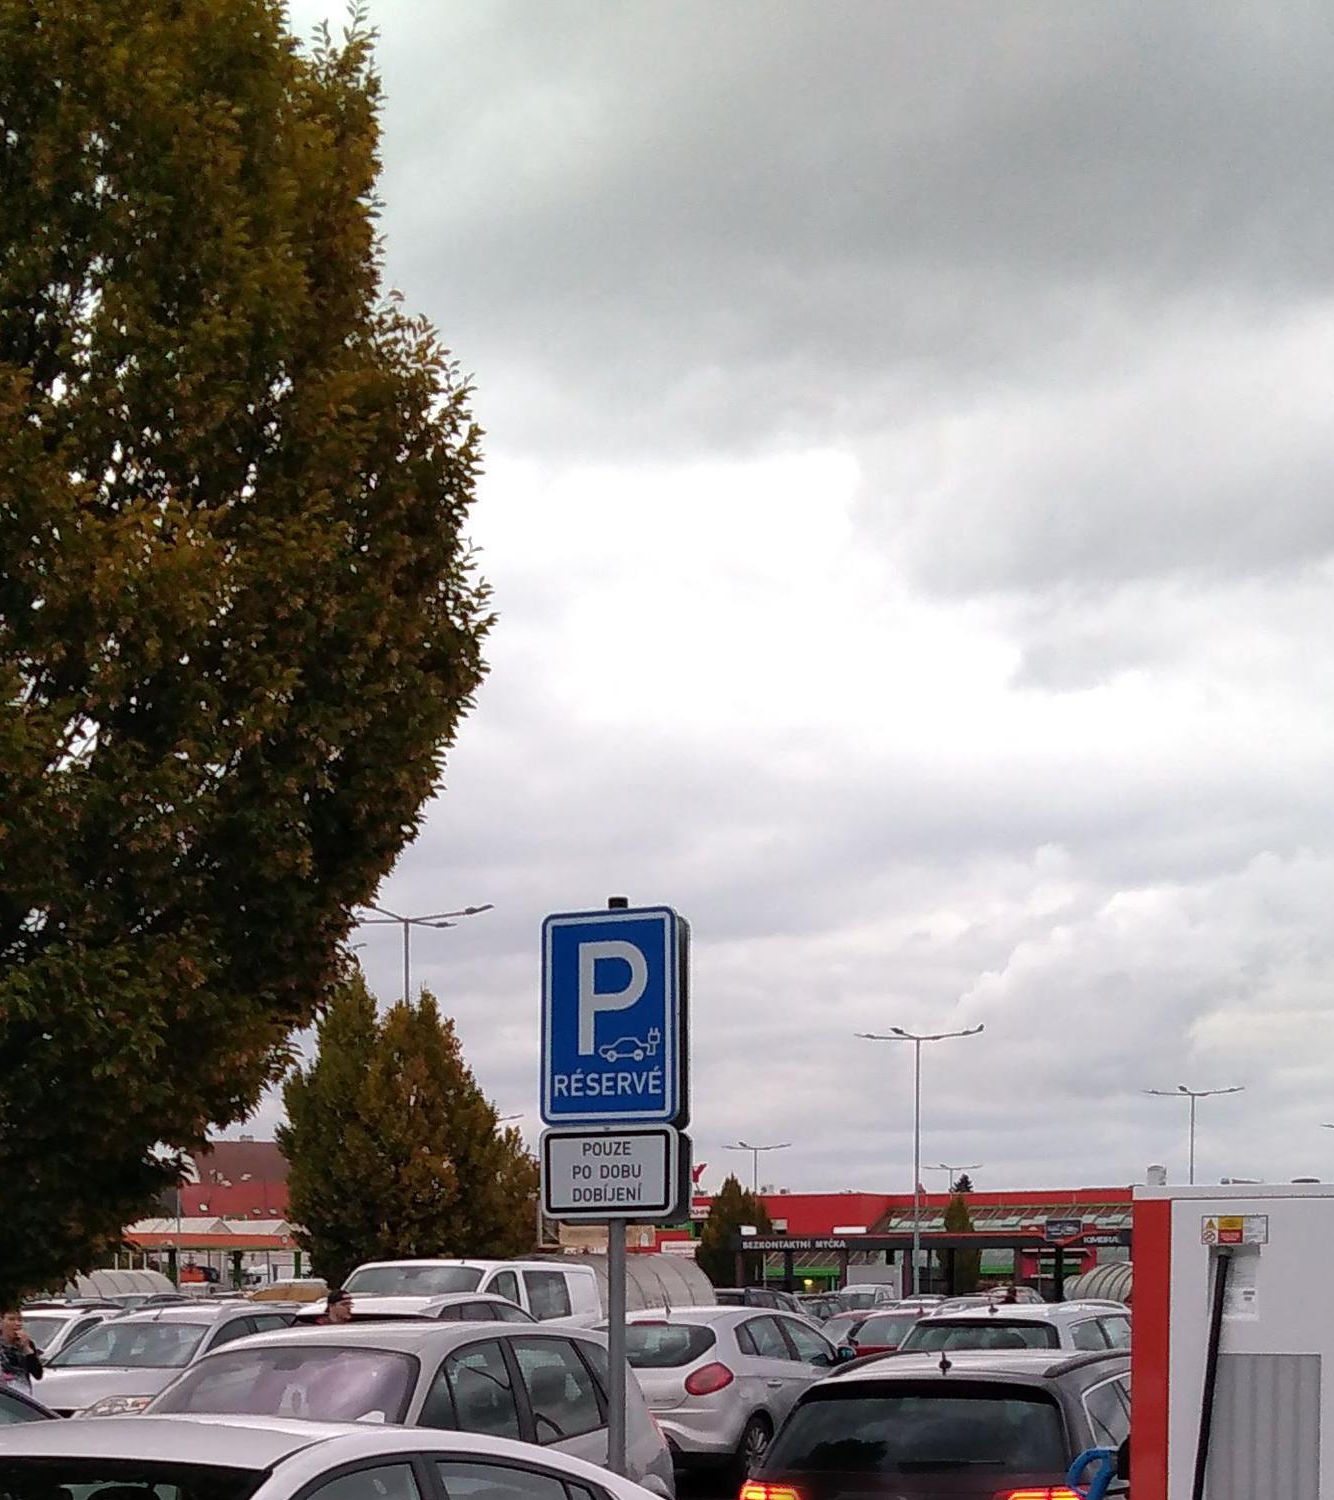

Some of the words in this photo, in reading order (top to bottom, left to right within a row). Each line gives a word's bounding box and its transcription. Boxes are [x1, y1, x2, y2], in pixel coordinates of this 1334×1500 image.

[578, 940, 648, 1056] P
[553, 1066, 663, 1097] RÉSERVÉ
[582, 1141, 632, 1157] POUZE
[572, 1165, 592, 1180] PO
[600, 1164, 642, 1180] DOBU
[572, 1182, 643, 1203] DOBÍJENÍ
